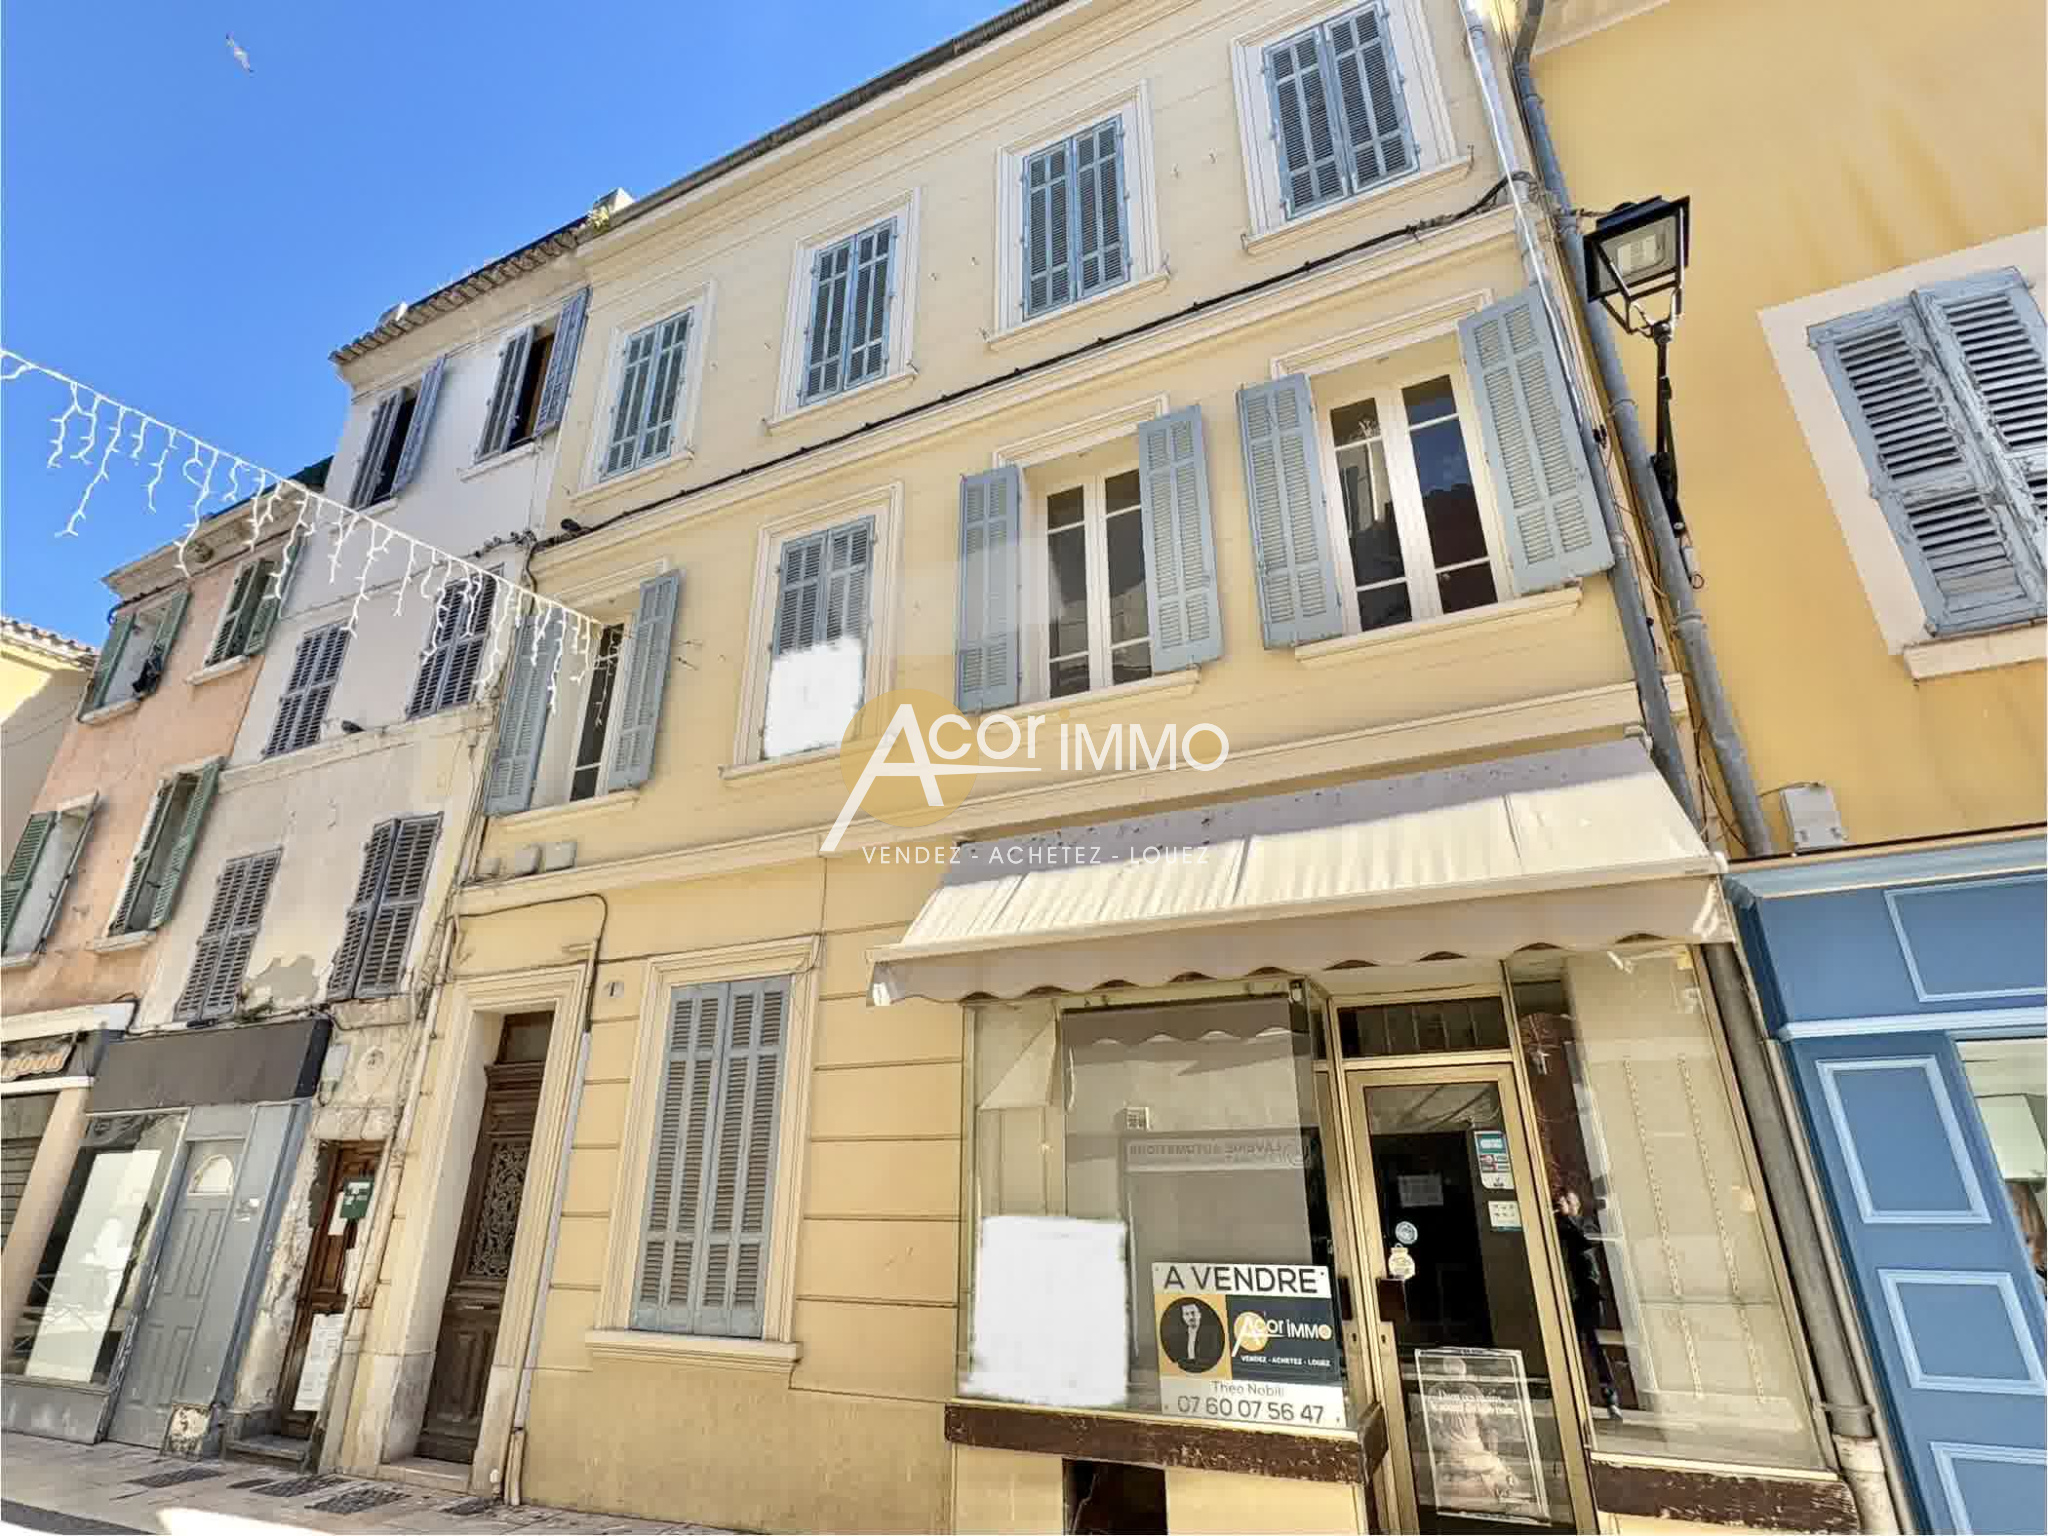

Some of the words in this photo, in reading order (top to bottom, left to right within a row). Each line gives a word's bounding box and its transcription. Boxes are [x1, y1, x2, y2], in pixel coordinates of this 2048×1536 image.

[1164, 1265, 1185, 1290] A
[1191, 1266, 1318, 1294] VENDRE
[1177, 1395, 1200, 1414] 07
[1205, 1397, 1233, 1416] 60
[1238, 1399, 1262, 1419] 07
[1267, 1401, 1295, 1421] 56
[1300, 1404, 1325, 1424] 47
